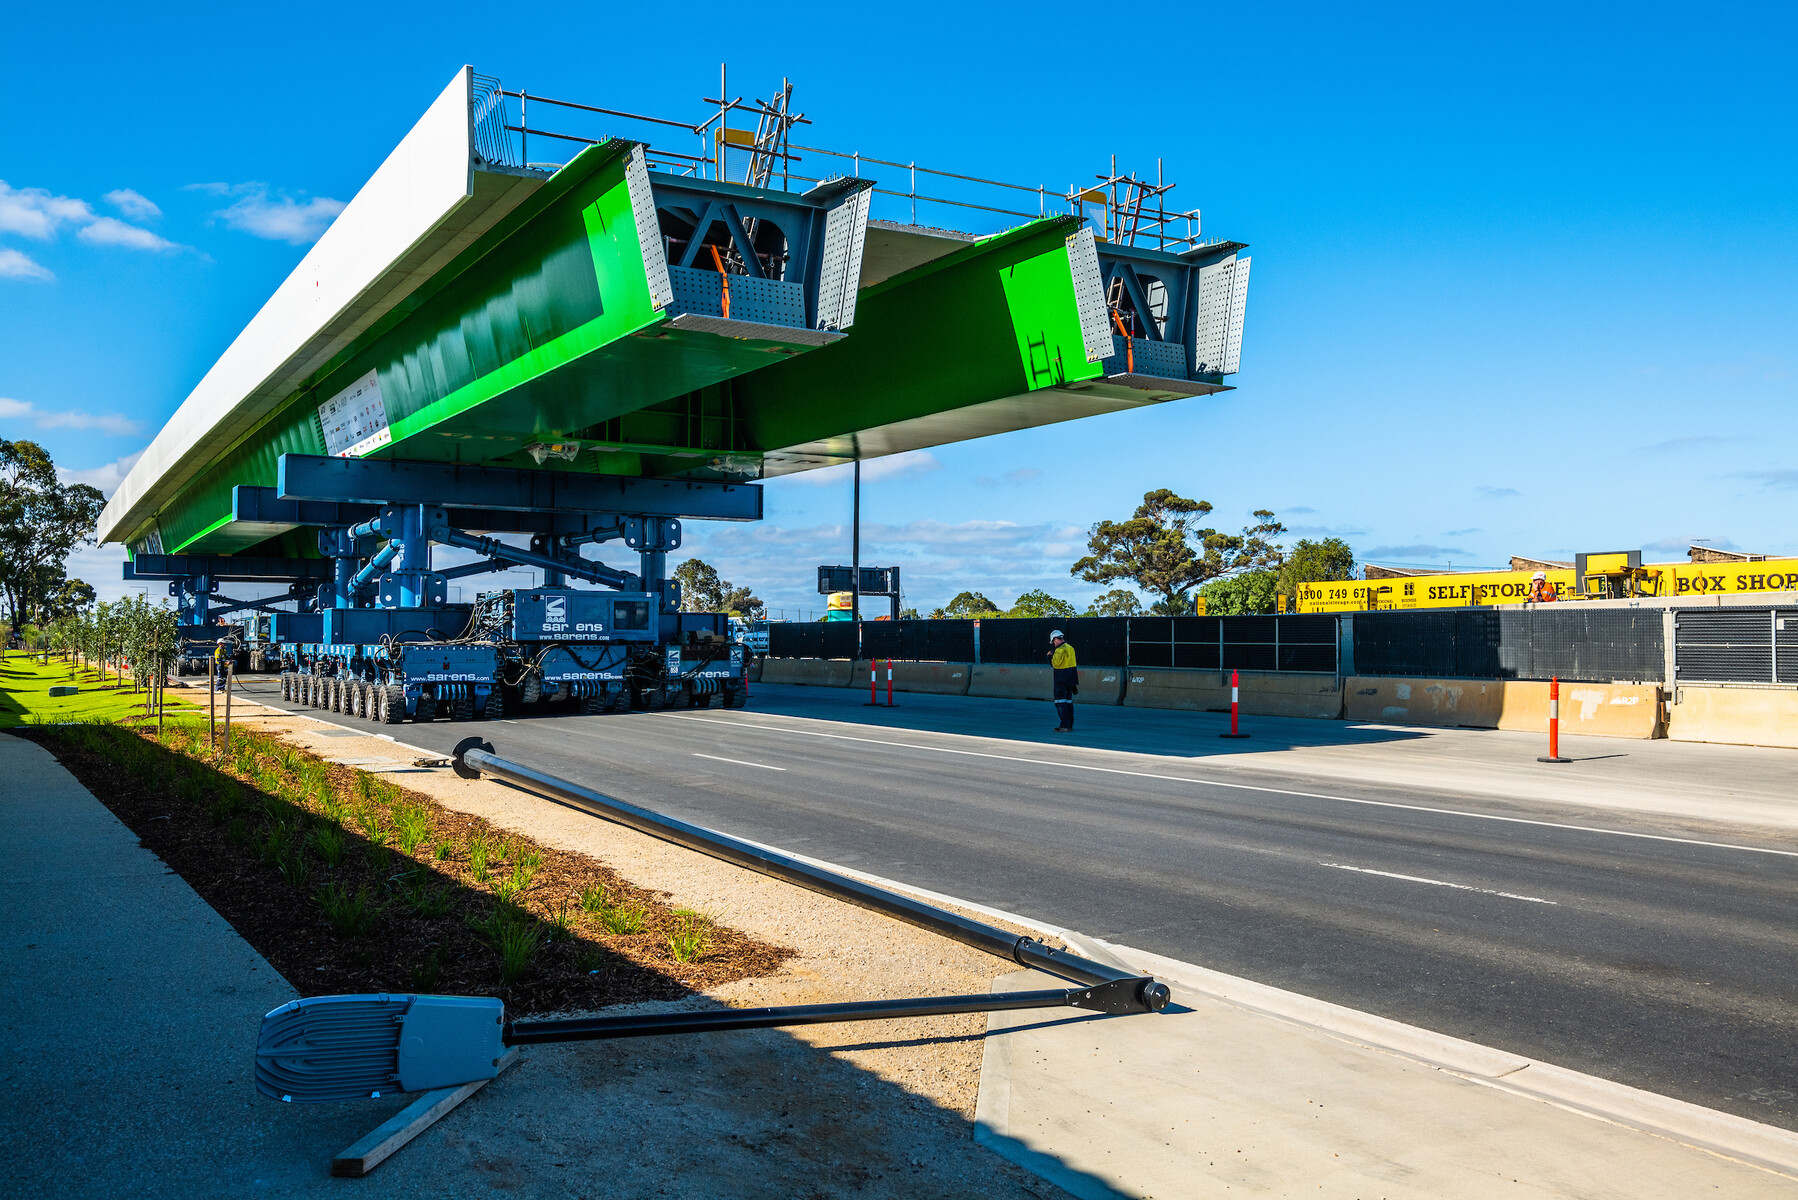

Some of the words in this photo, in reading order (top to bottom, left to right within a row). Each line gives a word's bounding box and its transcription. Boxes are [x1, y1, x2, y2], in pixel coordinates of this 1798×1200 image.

[1677, 576, 1726, 592] BOX
[1737, 573, 1798, 590] SHOP
[1299, 590, 1322, 600] 1300
[1329, 588, 1347, 599] 749
[1353, 588, 1366, 598] 67
[1428, 585, 1470, 599] SELF
[1481, 582, 1566, 597] STORE
[539, 633, 610, 641] www.sarens.com
[410, 673, 490, 682] www.sarens.com
[544, 672, 624, 681] www.sarens.com
[1622, 696, 1639, 705] R2P
